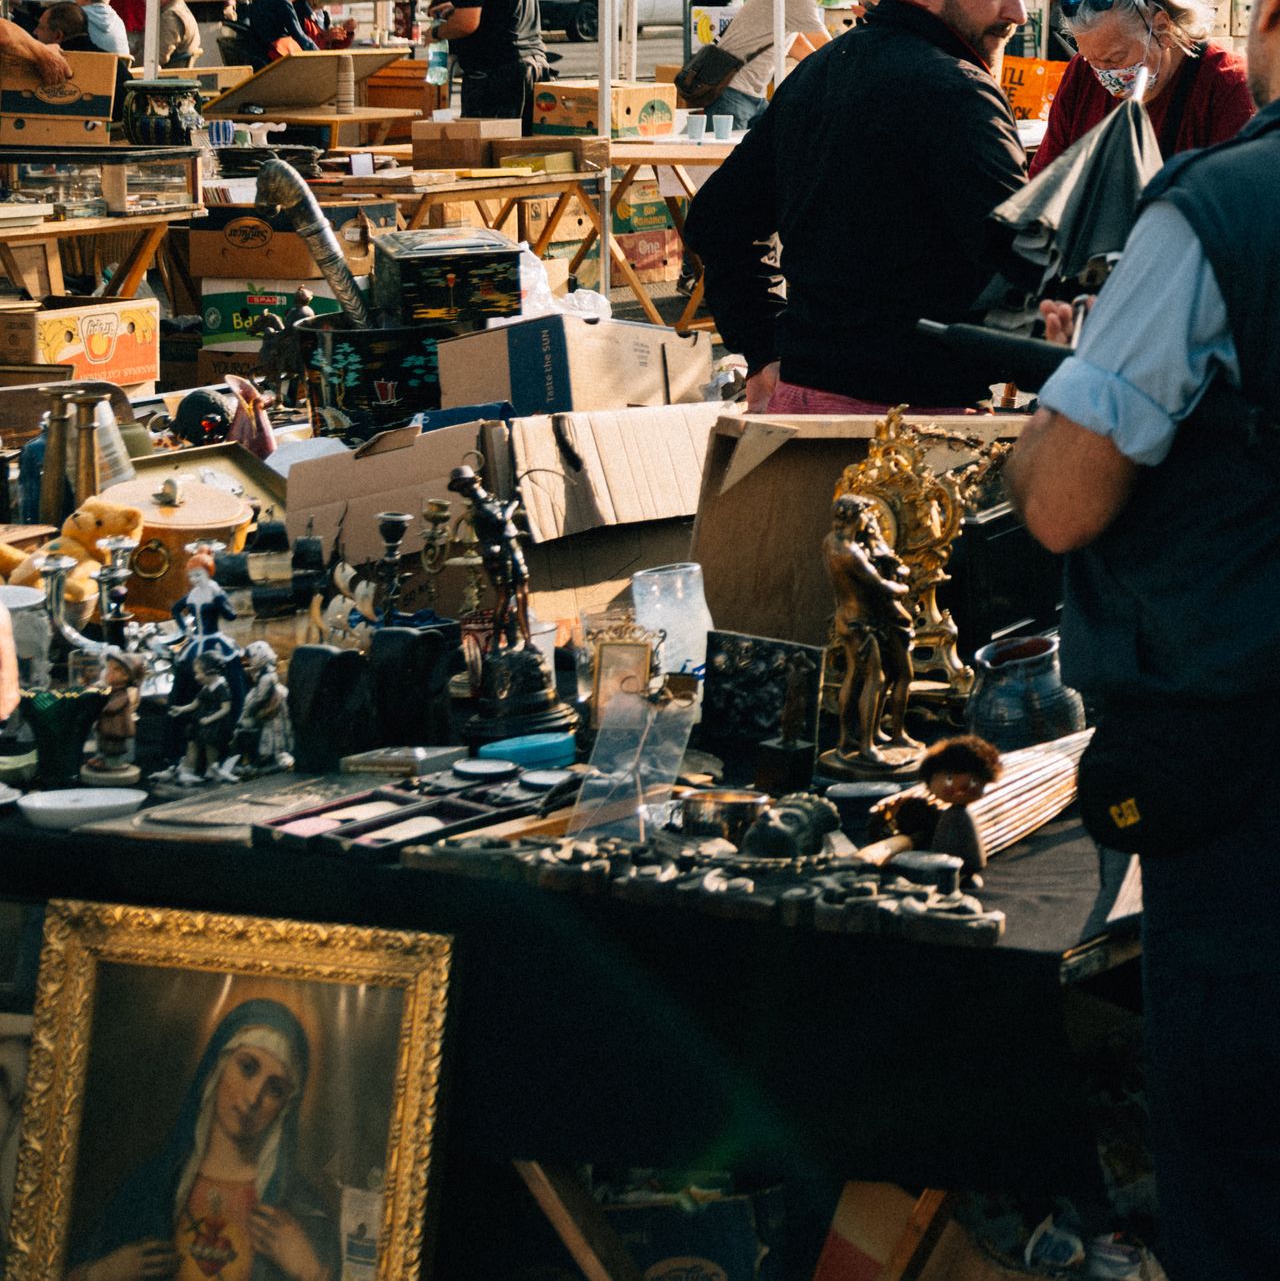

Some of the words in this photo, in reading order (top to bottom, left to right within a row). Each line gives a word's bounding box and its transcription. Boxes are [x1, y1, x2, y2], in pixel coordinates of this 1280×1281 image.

[228, 225, 268, 242] SanLucar
[639, 239, 661, 256] One
[541, 329, 550, 352] SUN
[543, 354, 553, 370] the
[546, 374, 555, 403] Taste
